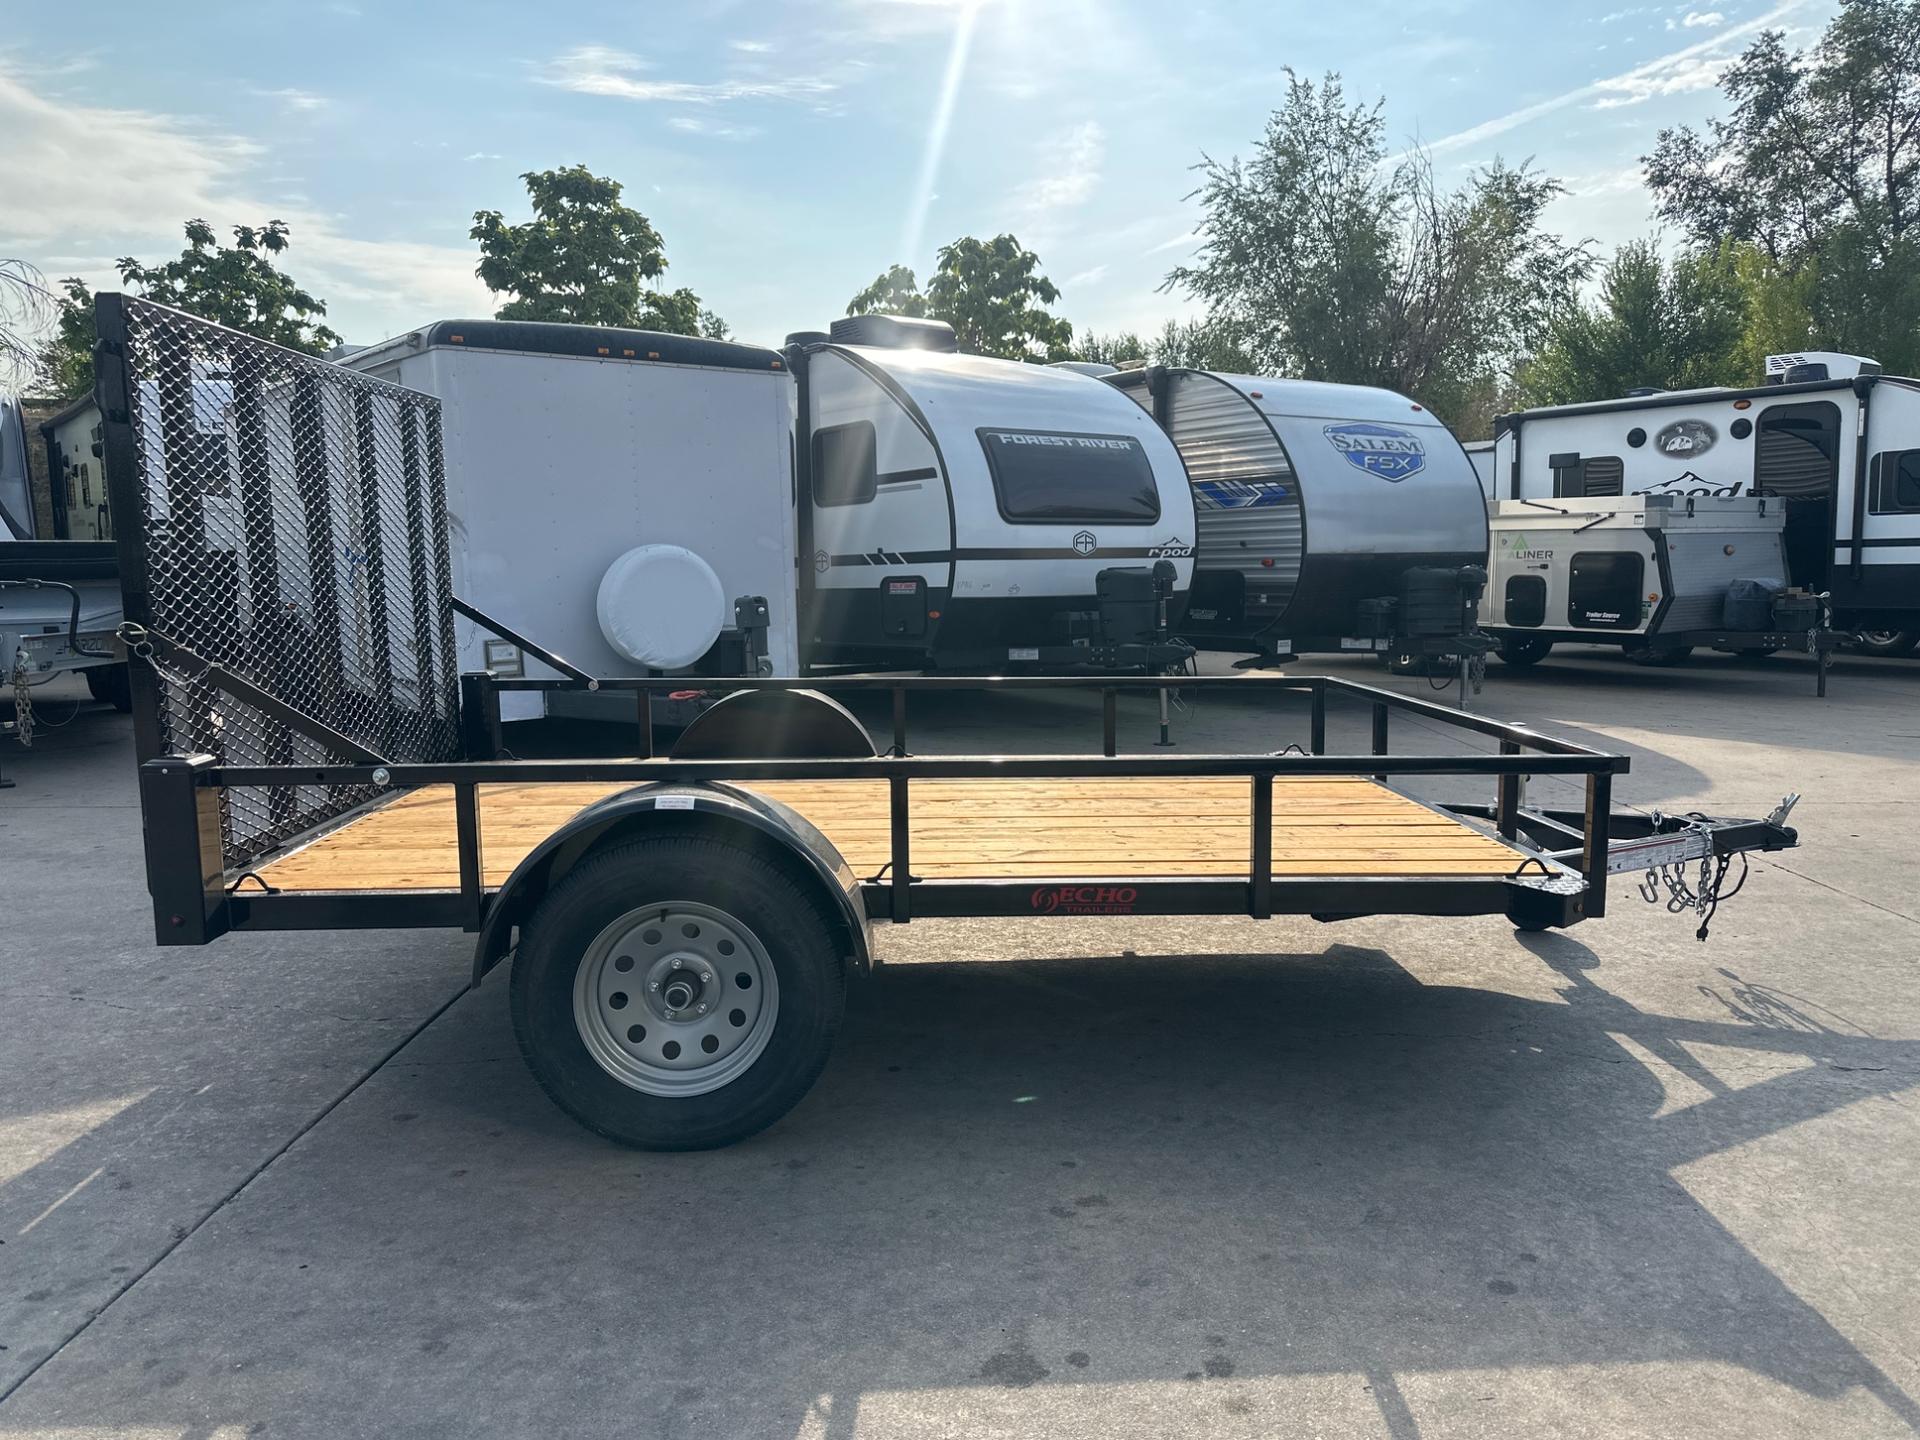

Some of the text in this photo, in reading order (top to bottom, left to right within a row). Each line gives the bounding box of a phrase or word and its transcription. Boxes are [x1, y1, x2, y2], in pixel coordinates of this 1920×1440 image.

[998, 434, 1131, 450] FOREST RIVER
[1331, 434, 1423, 453] SALEM
[1364, 455, 1412, 470] FSX
[1147, 546, 1193, 559] r-pod
[1059, 887, 1137, 903] ECHO
